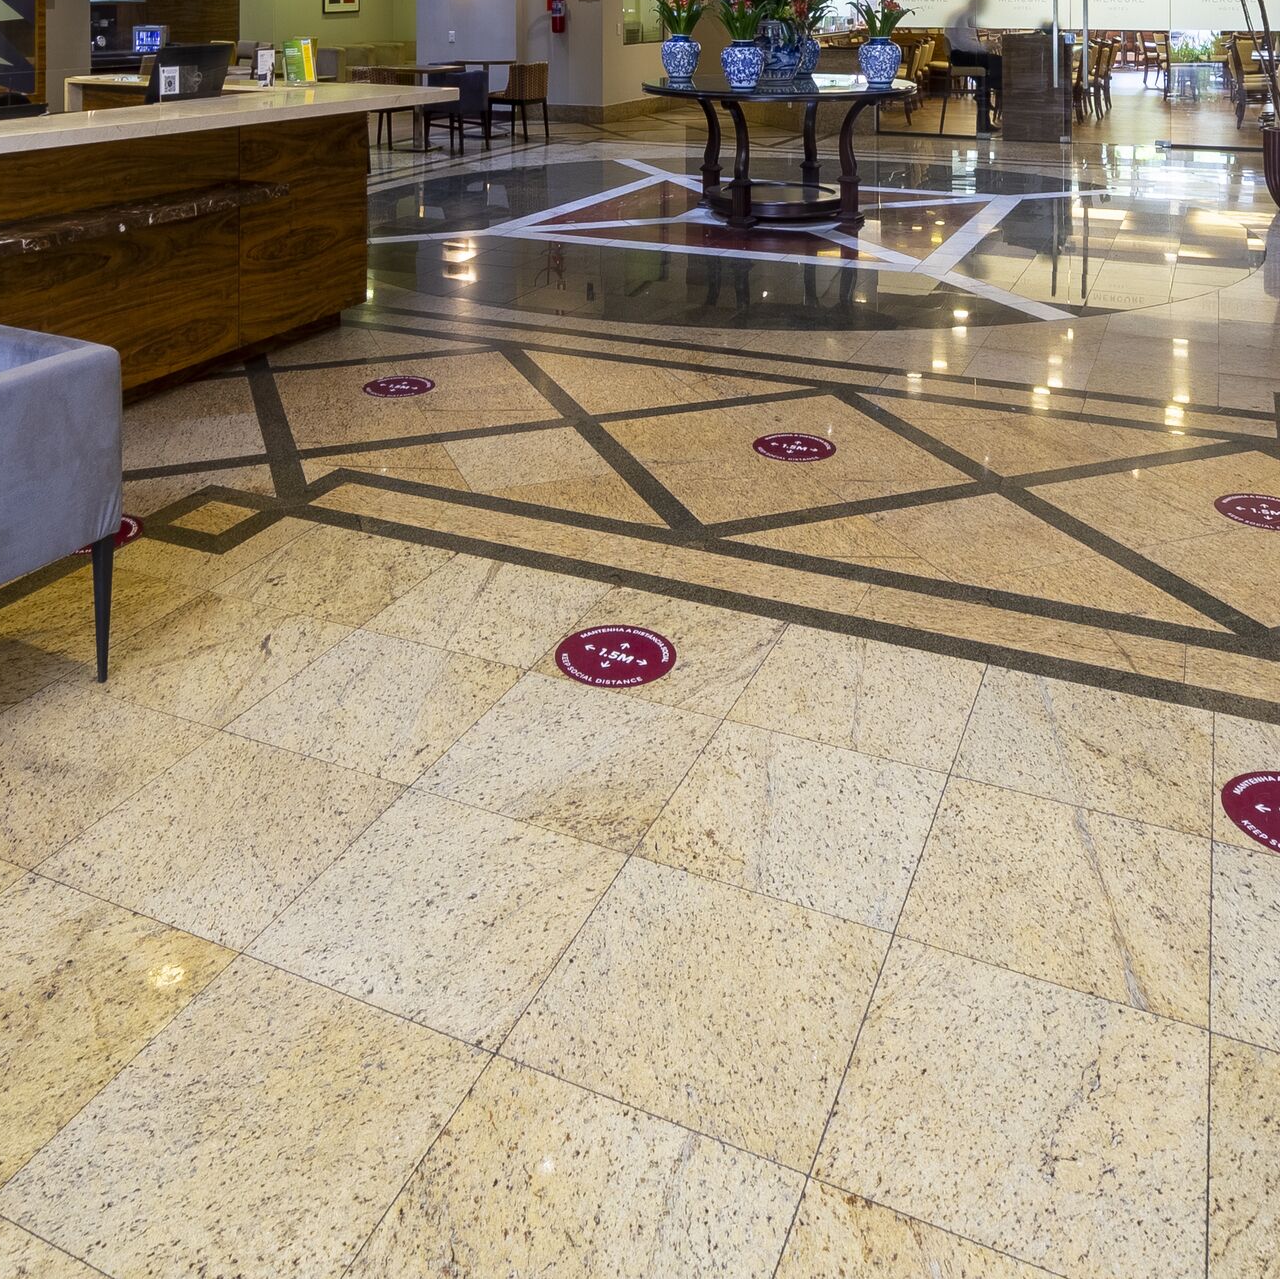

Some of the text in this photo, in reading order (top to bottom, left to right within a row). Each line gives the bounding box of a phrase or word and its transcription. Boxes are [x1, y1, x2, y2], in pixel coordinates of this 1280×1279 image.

[580, 627, 624, 639] MANTENHA
[598, 647, 634, 664] 1.5M
[567, 666, 593, 682] SOCIAL
[595, 676, 643, 685] DISTANCE
[1232, 775, 1276, 795] MANTENHA
[1240, 819, 1269, 840] KEEP
